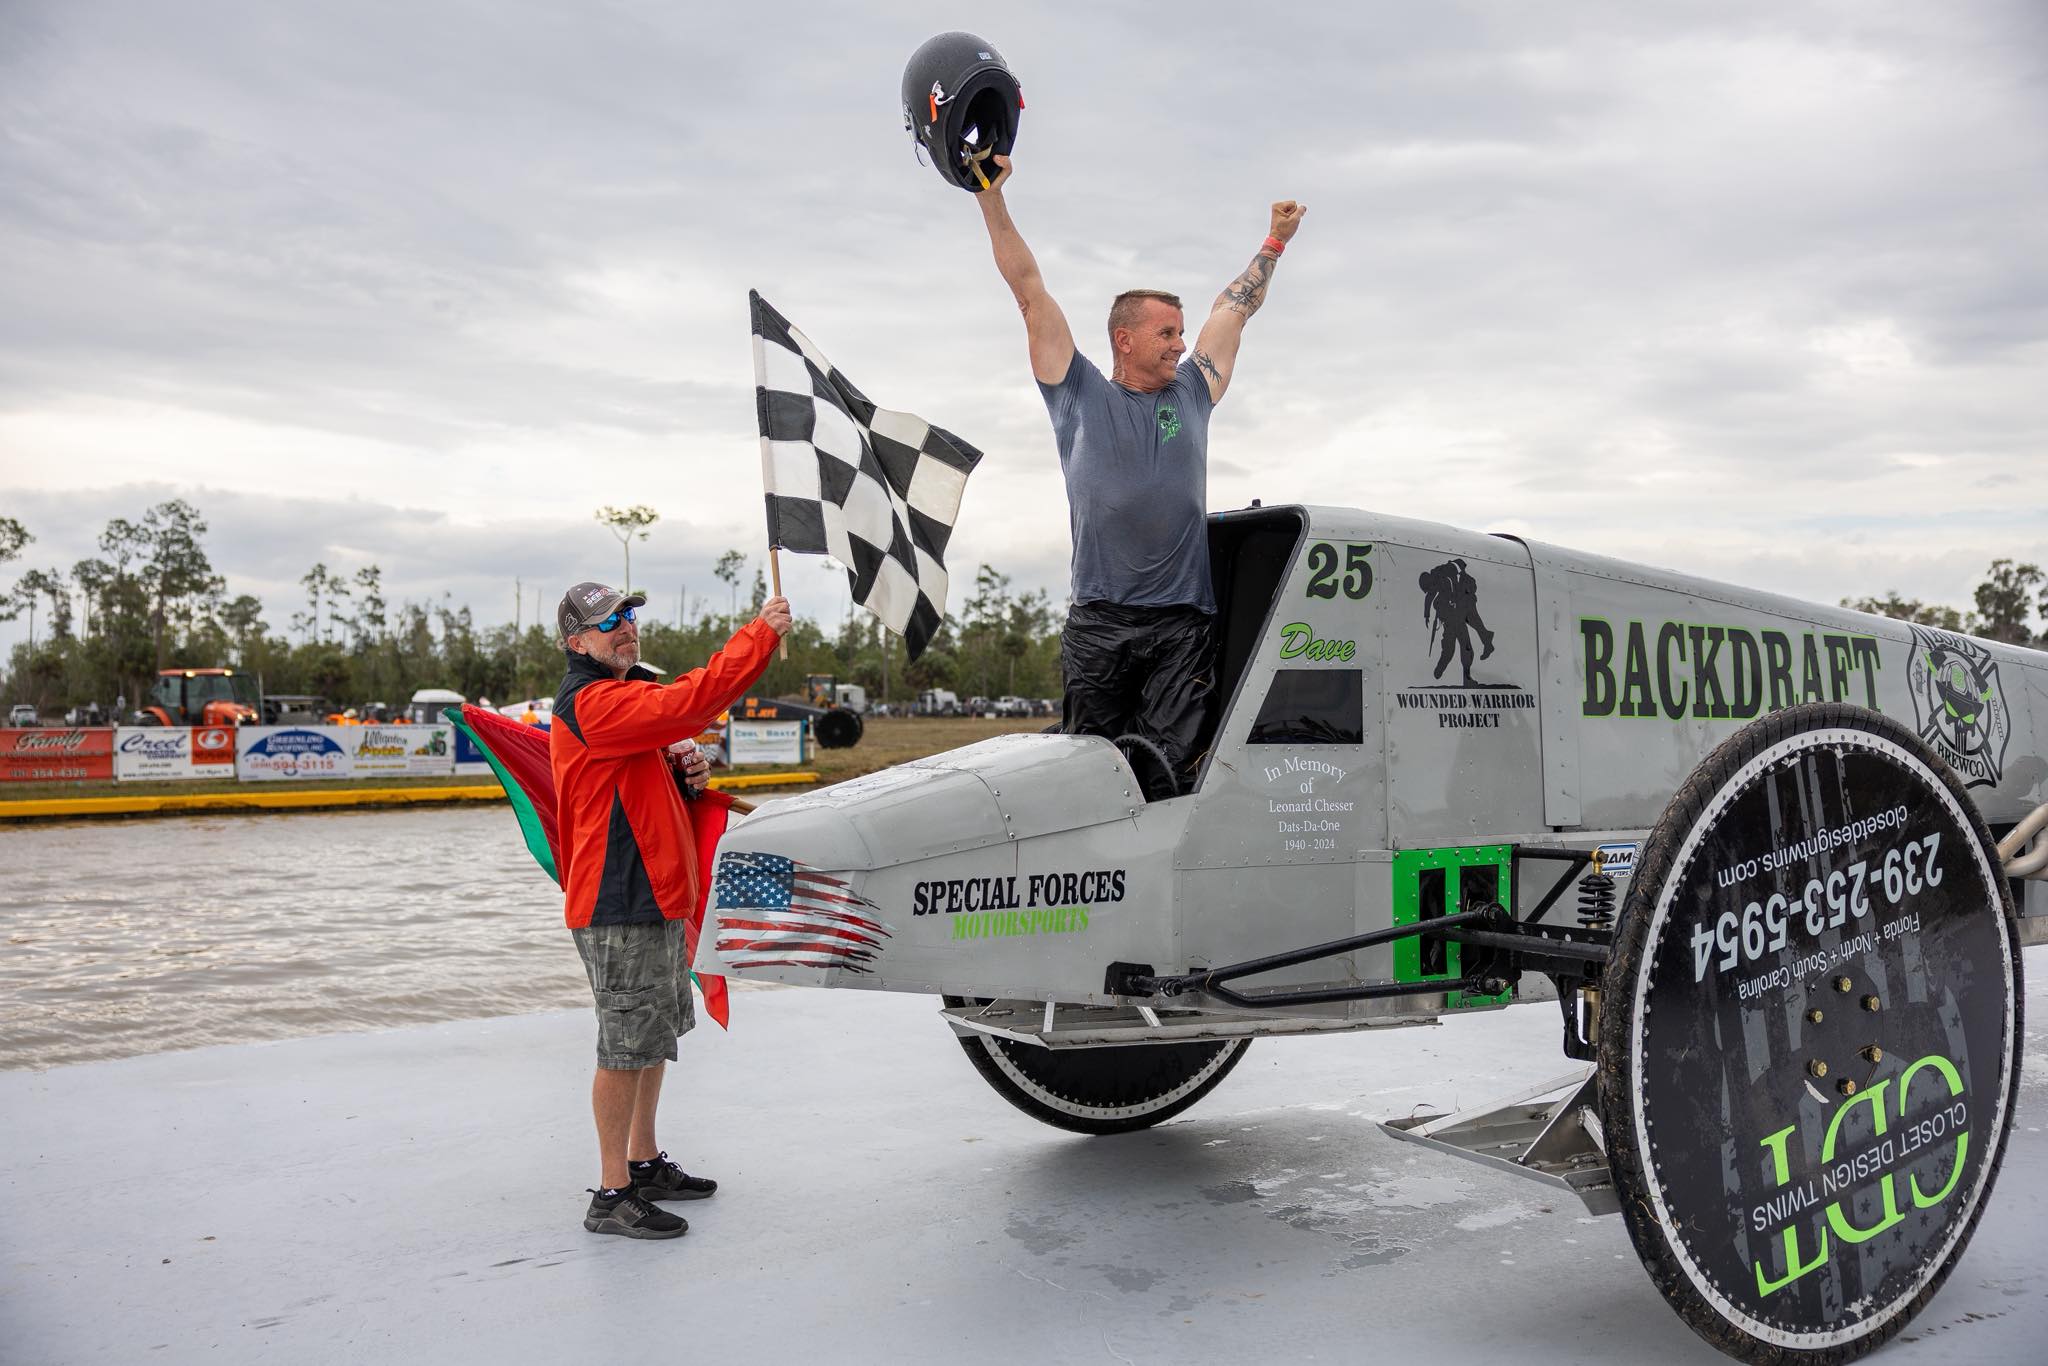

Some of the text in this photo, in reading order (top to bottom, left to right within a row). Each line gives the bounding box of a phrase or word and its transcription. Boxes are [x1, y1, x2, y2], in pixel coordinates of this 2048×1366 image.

[1305, 541, 1374, 601] 25
[1280, 622, 1356, 662] Dave
[1580, 617, 1881, 720] BACKDRAFT
[1396, 693, 1536, 709] WOUNDED WARRIOR
[1438, 713, 1500, 728] PROJECT
[13, 728, 88, 752] Family
[120, 733, 187, 753] Creel
[1264, 756, 1347, 784] In Memory
[1937, 740, 1985, 777] BREWCO
[1300, 777, 1315, 794] of
[1269, 798, 1354, 813] Leonard Chesser
[1278, 819, 1340, 833] Dats-Da-One
[1284, 839, 1306, 850] 1940
[1313, 838, 1335, 849] 2024
[1717, 804, 1909, 888] closetdesigntwins.com
[913, 869, 1126, 916] SPECIAL FORCES
[1690, 831, 1943, 983] 239-253-5954
[951, 906, 1090, 940] MOTORSPORTS
[1738, 911, 1920, 1000] Florida + North + South Carolina
[1752, 1102, 1968, 1232] CLOSET DESIGN TWINS
